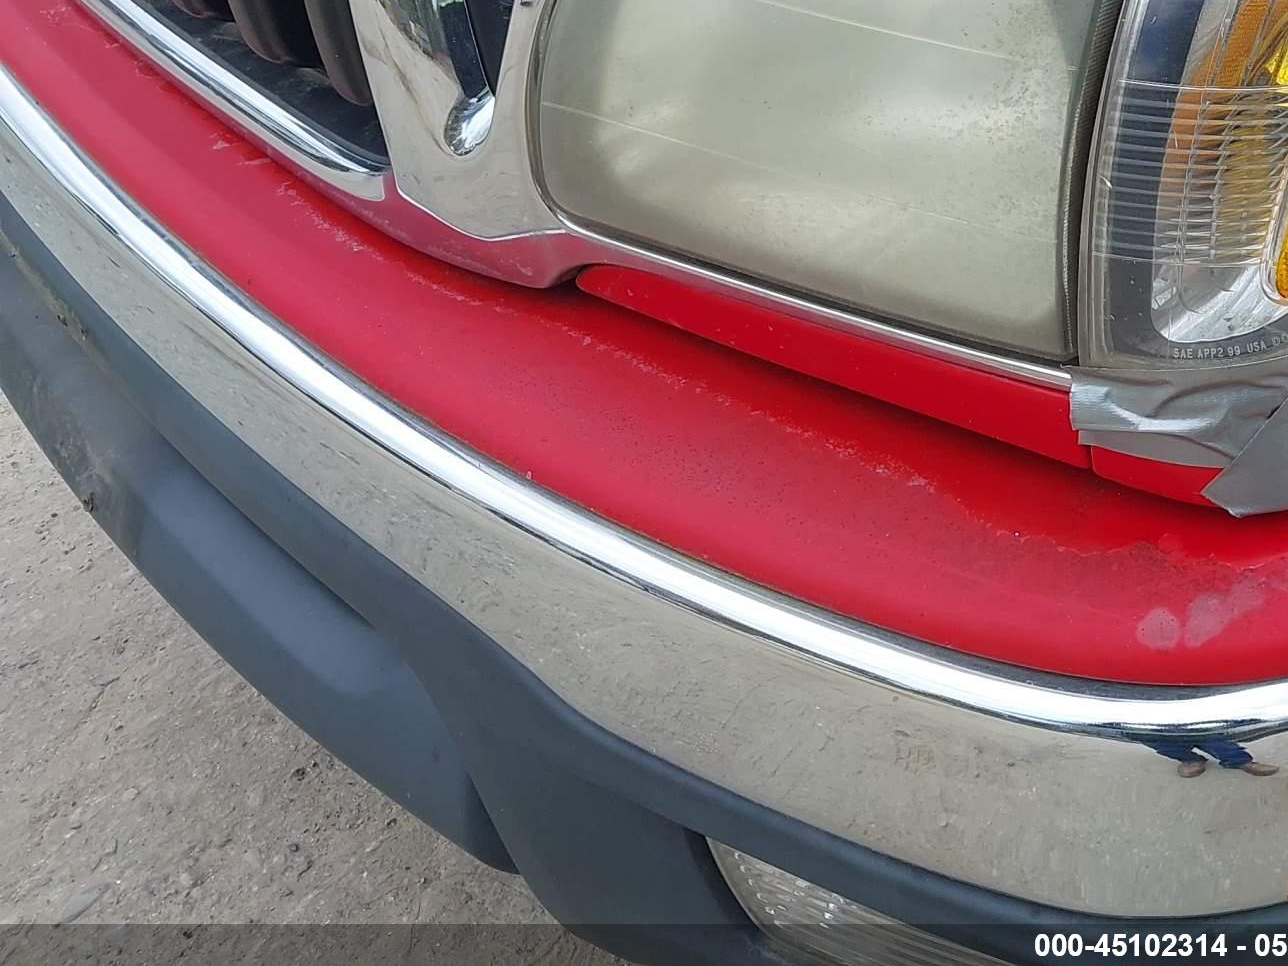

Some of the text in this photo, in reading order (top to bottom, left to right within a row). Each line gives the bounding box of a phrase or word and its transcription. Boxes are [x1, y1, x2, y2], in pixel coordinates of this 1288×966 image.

[1173, 347, 1193, 359] SAE
[1227, 345, 1241, 357] 99
[1246, 340, 1267, 353] USA
